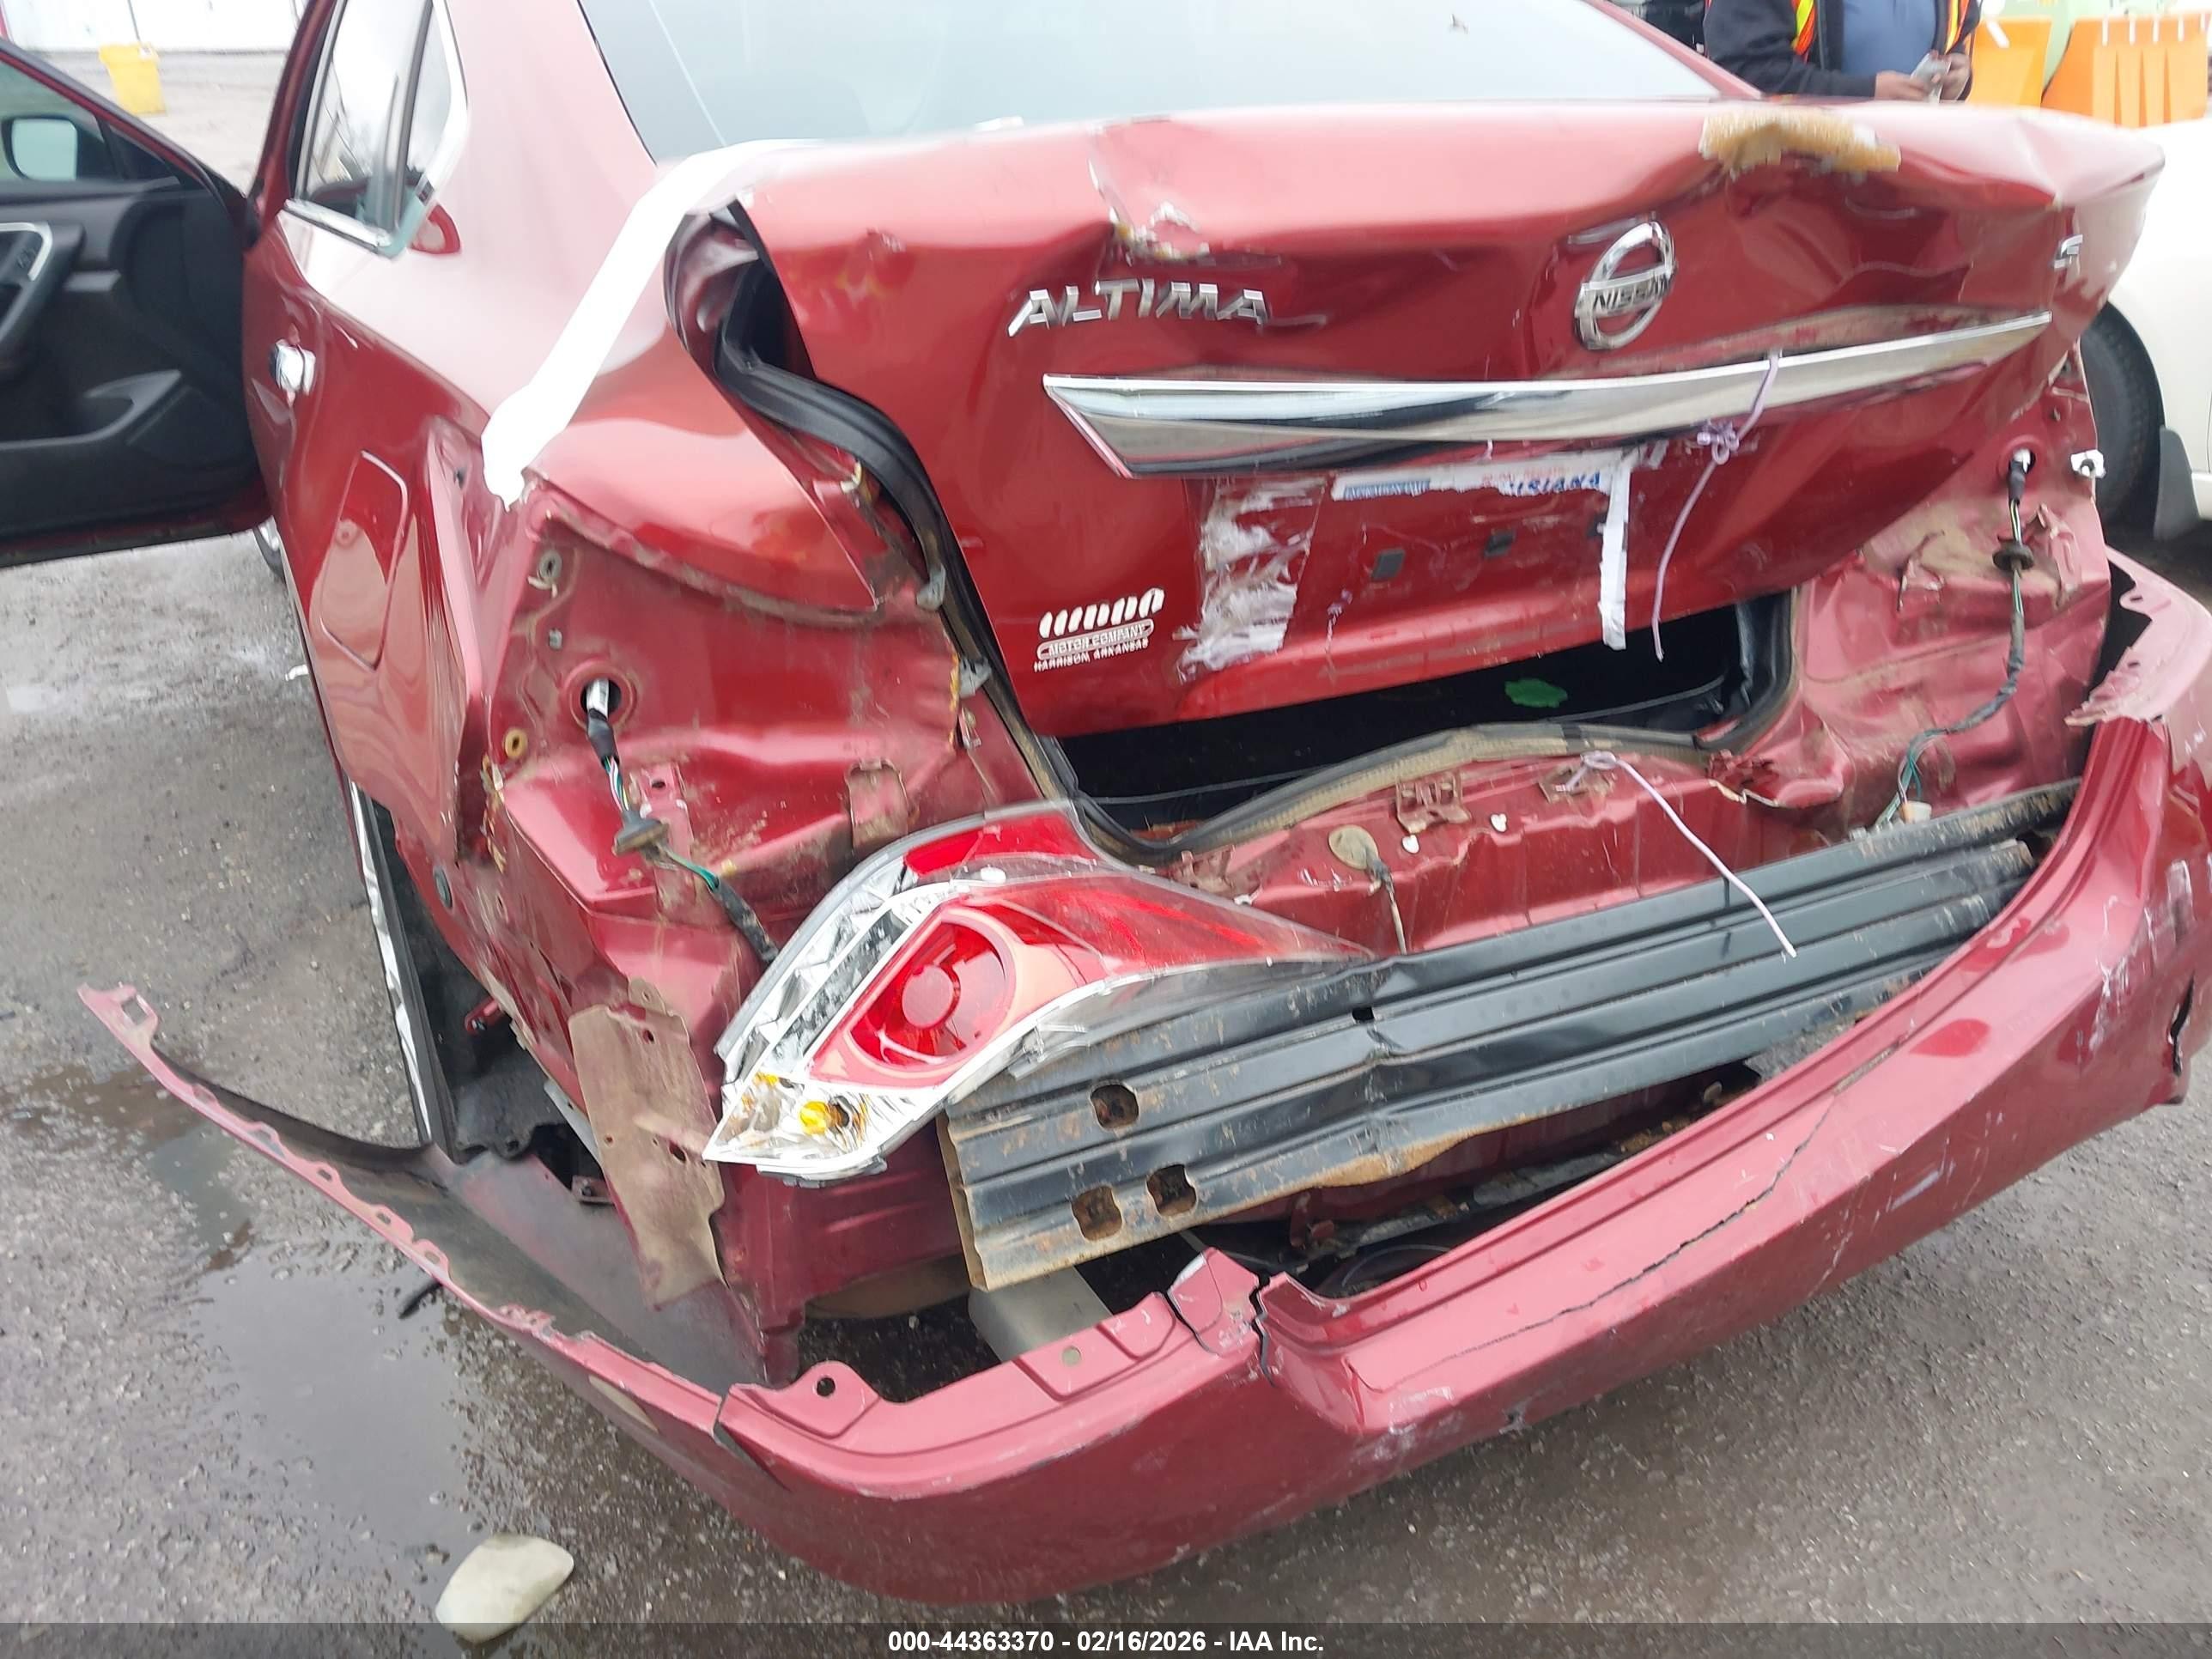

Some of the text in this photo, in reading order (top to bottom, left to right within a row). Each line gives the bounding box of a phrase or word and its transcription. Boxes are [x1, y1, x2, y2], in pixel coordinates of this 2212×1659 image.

[1007, 277, 1269, 337] ALTIMA
[1592, 273, 1669, 310] NISSAN
[1048, 623, 1146, 657] MOTOR COMPANY
